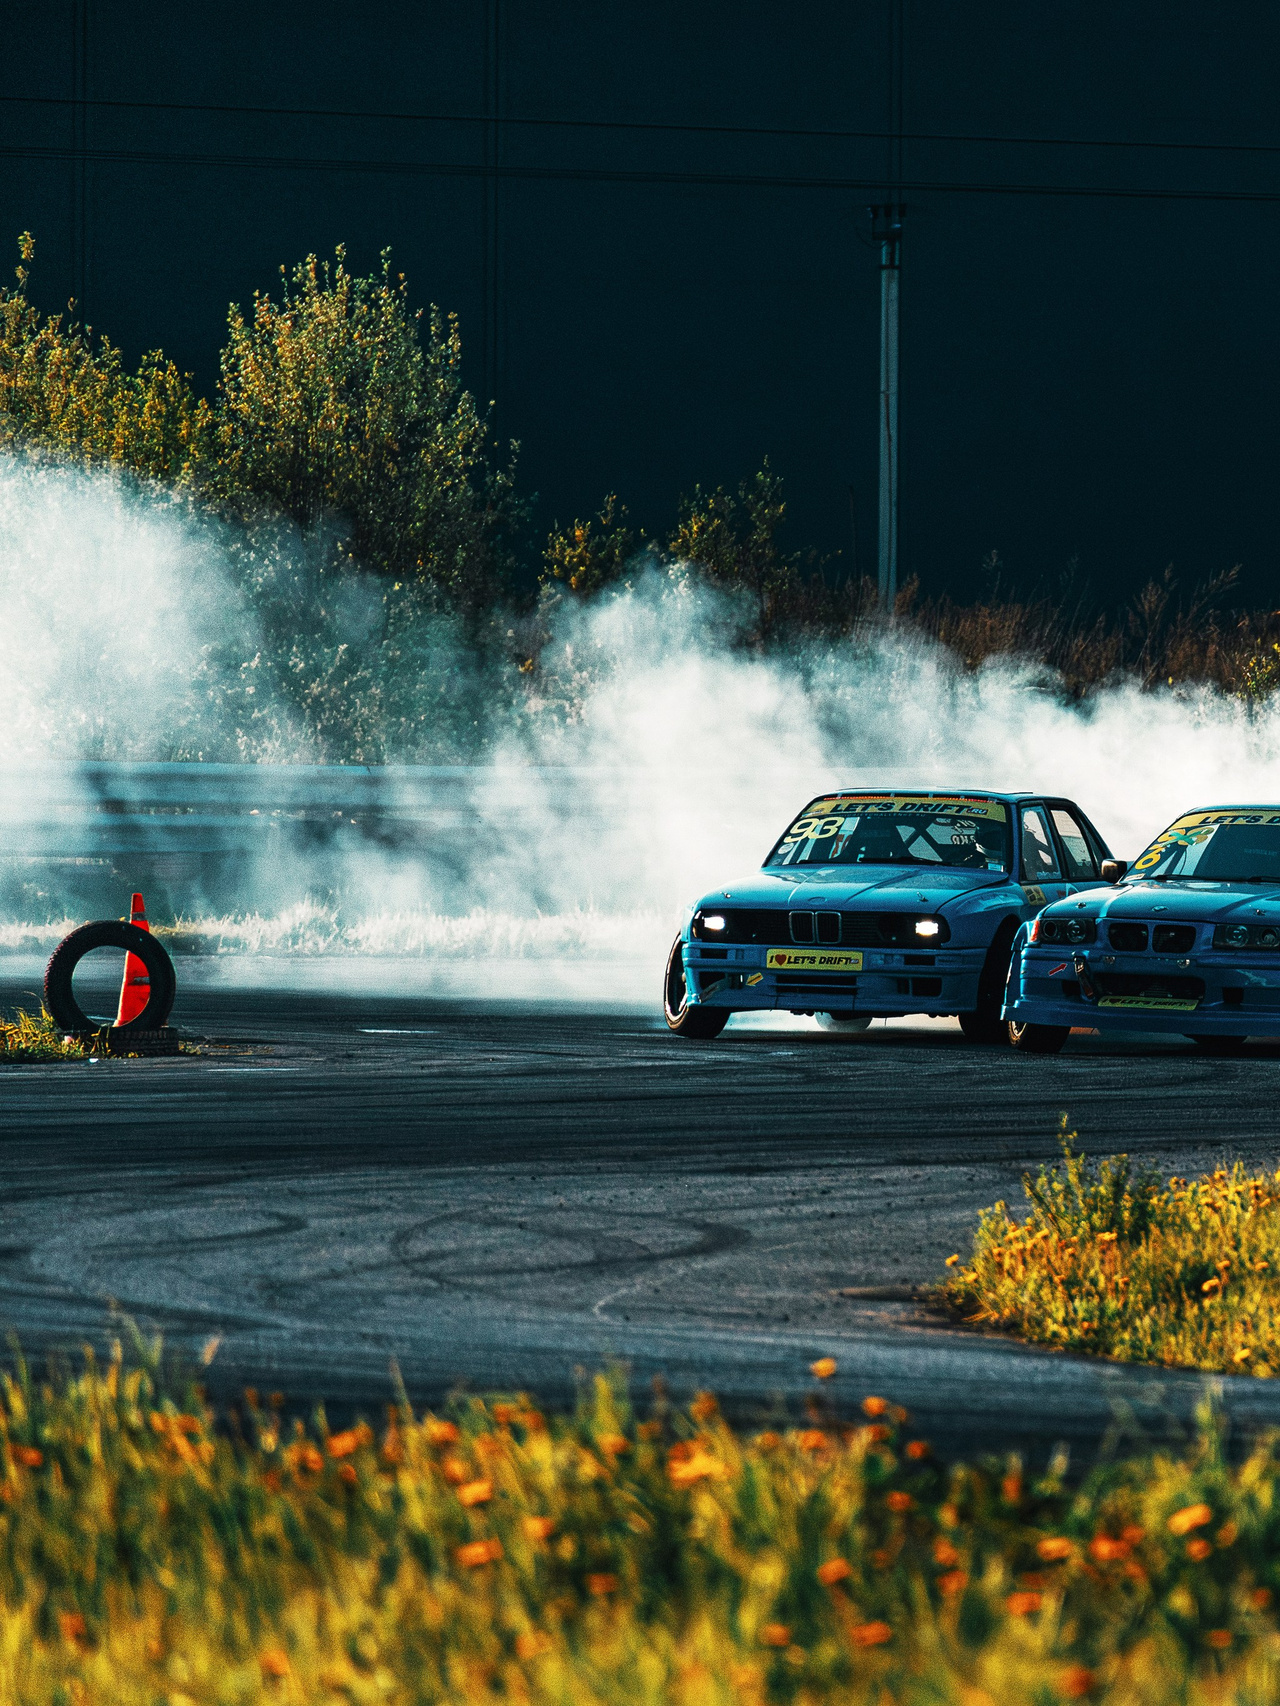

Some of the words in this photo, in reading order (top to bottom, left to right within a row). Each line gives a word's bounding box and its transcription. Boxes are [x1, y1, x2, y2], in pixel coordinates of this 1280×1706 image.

[829, 802, 896, 813] LET'S
[1198, 815, 1264, 825] LET'S
[783, 816, 845, 843] 93
[769, 955, 775, 964] I
[786, 955, 817, 965] LET'S
